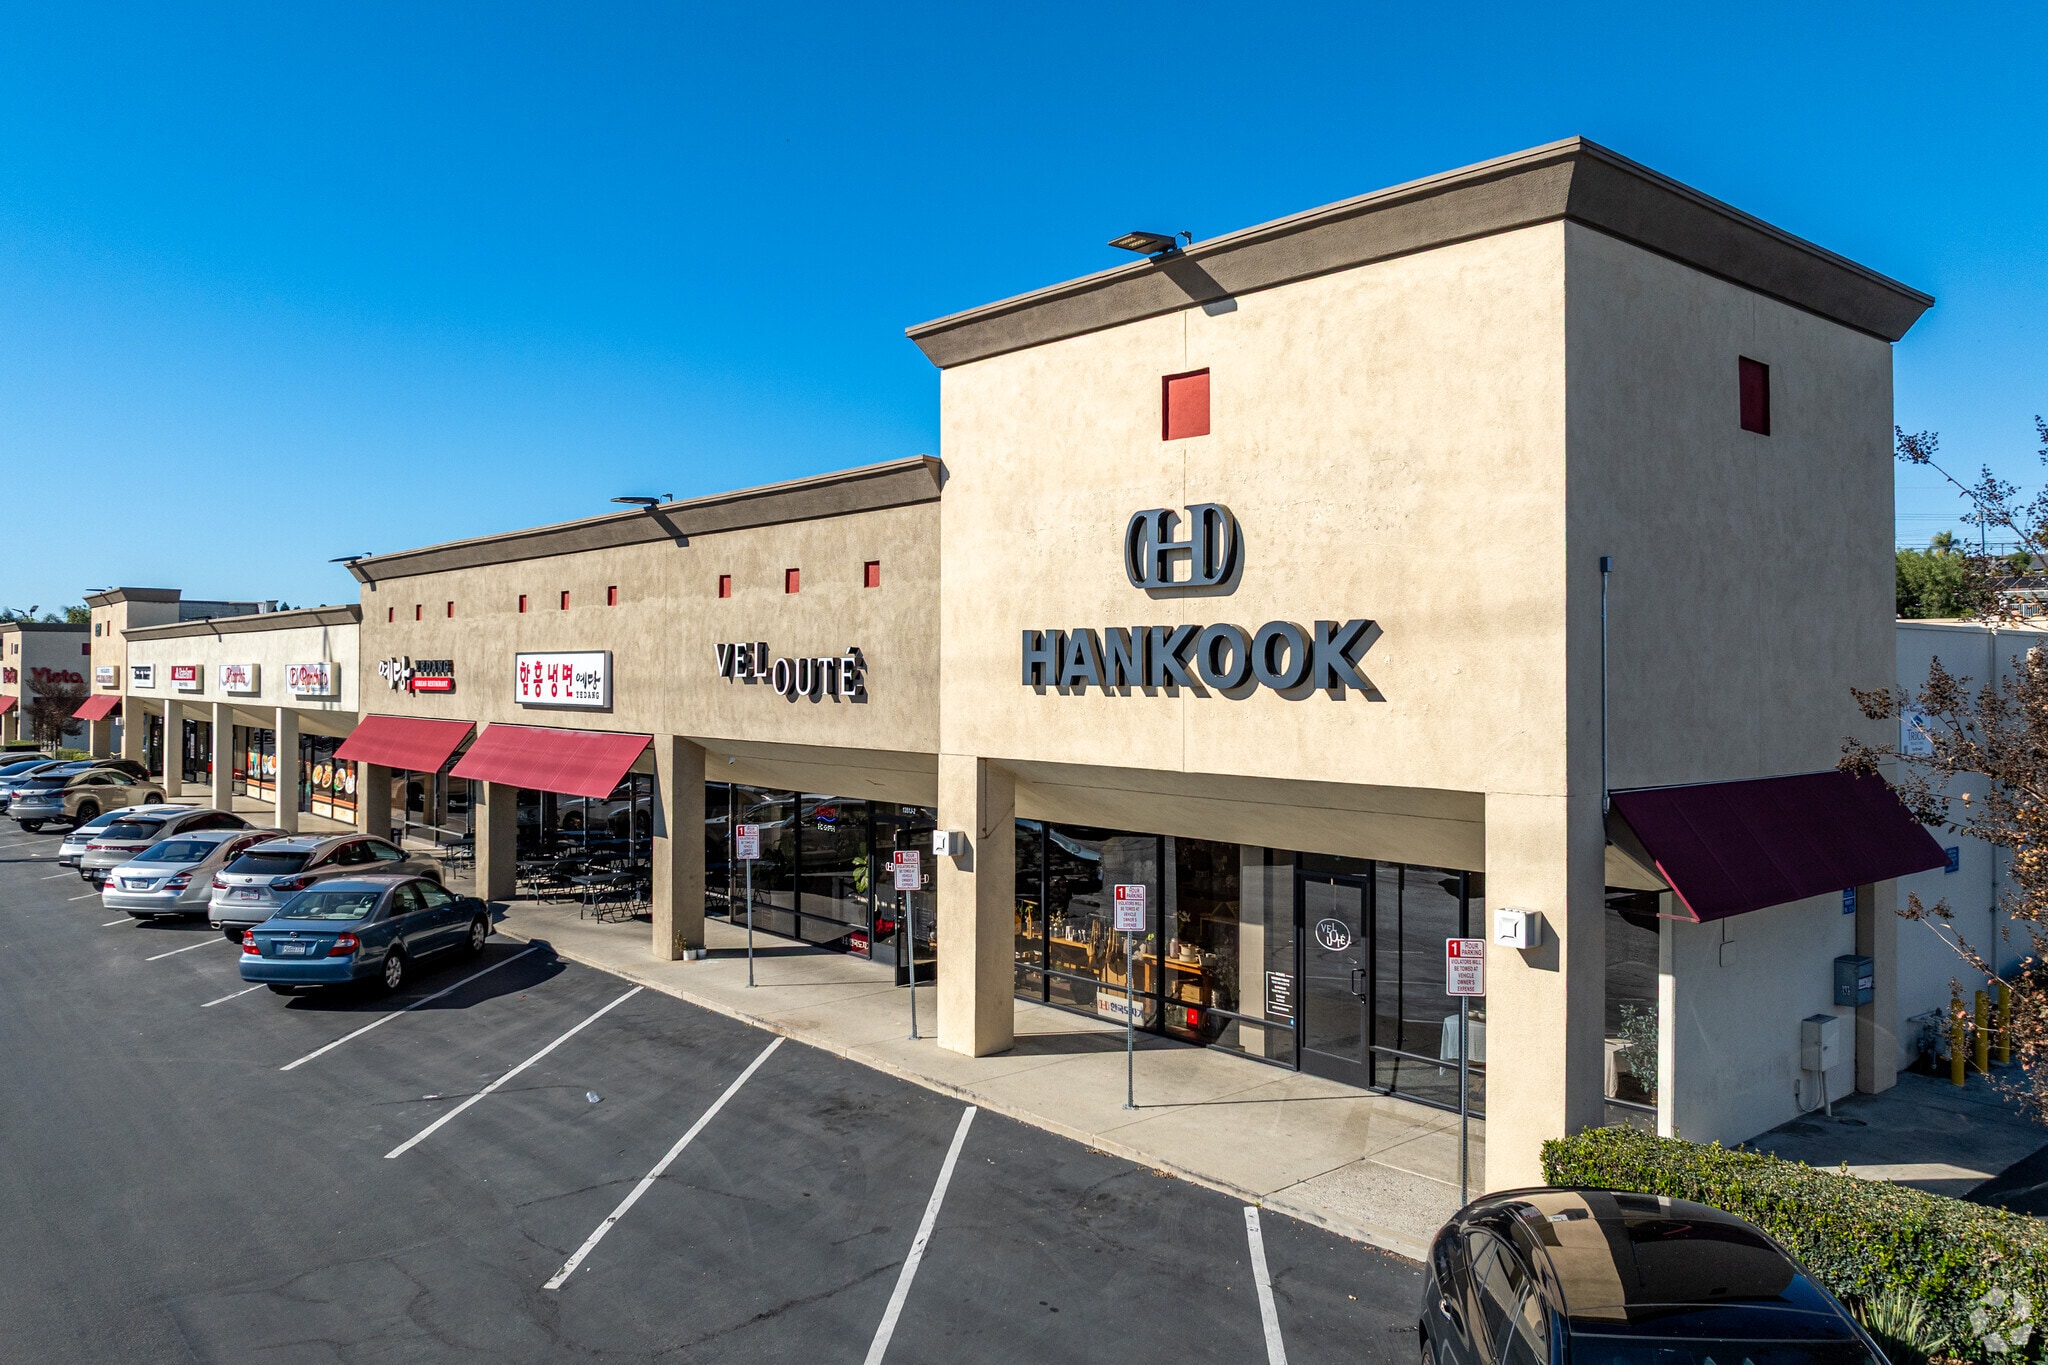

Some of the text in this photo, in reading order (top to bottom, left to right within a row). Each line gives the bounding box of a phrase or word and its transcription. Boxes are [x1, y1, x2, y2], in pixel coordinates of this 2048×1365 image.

[1022, 619, 1378, 691] HANKOOK
[31, 667, 84, 684] Vista
[520, 661, 573, 698] 함흥냉면
[575, 691, 600, 700] YEDANG
[897, 853, 902, 863] 1
[1118, 887, 1123, 899] 1
[1451, 942, 1458, 956] 1
[1464, 942, 1479, 950] HOUR
